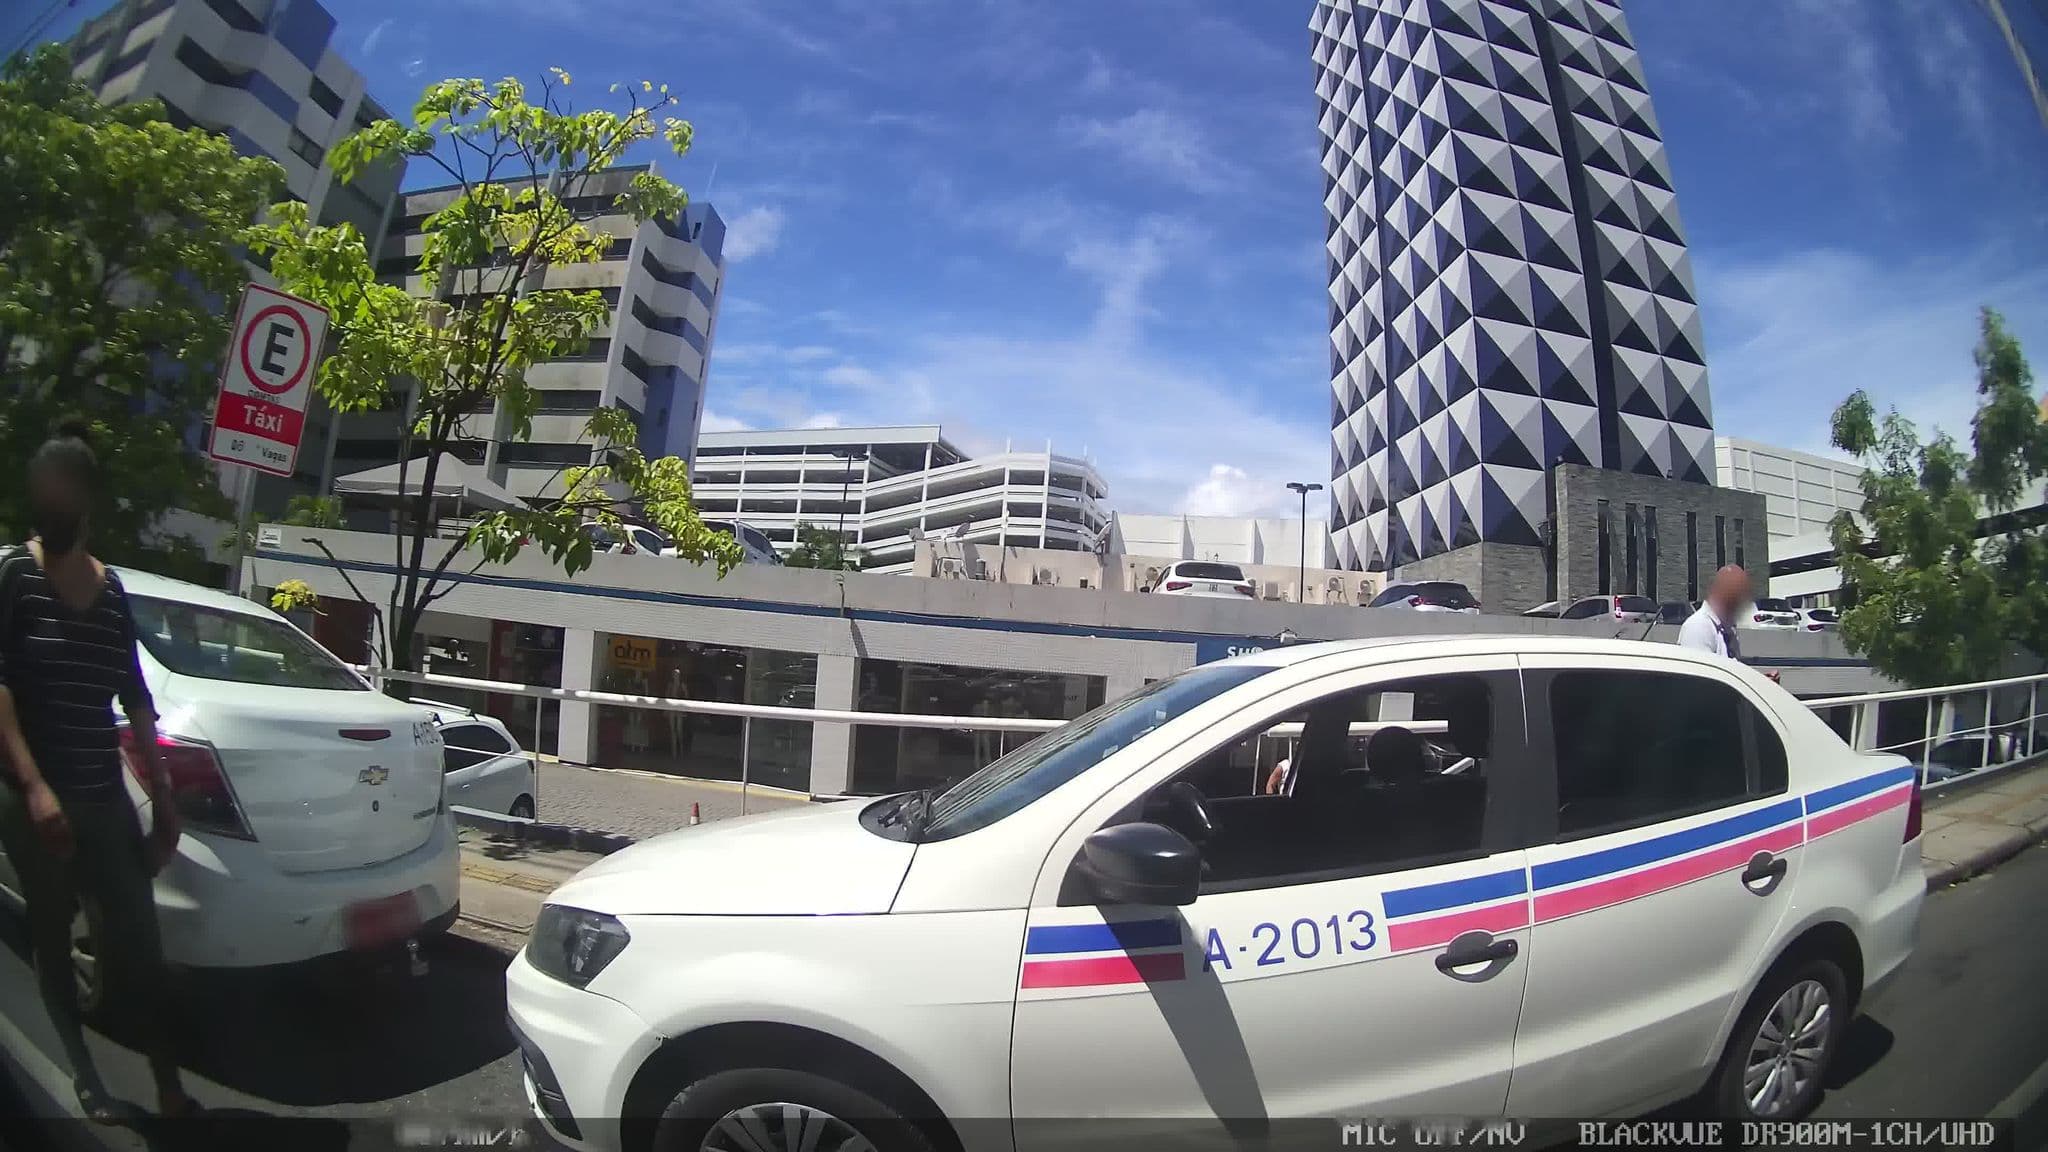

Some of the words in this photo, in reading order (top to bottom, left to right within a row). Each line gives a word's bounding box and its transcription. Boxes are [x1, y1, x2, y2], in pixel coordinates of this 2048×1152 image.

[260, 322, 295, 376] E
[243, 405, 284, 433] Táxi
[262, 447, 287, 463] Vagas
[1202, 910, 1377, 973] A-2013
